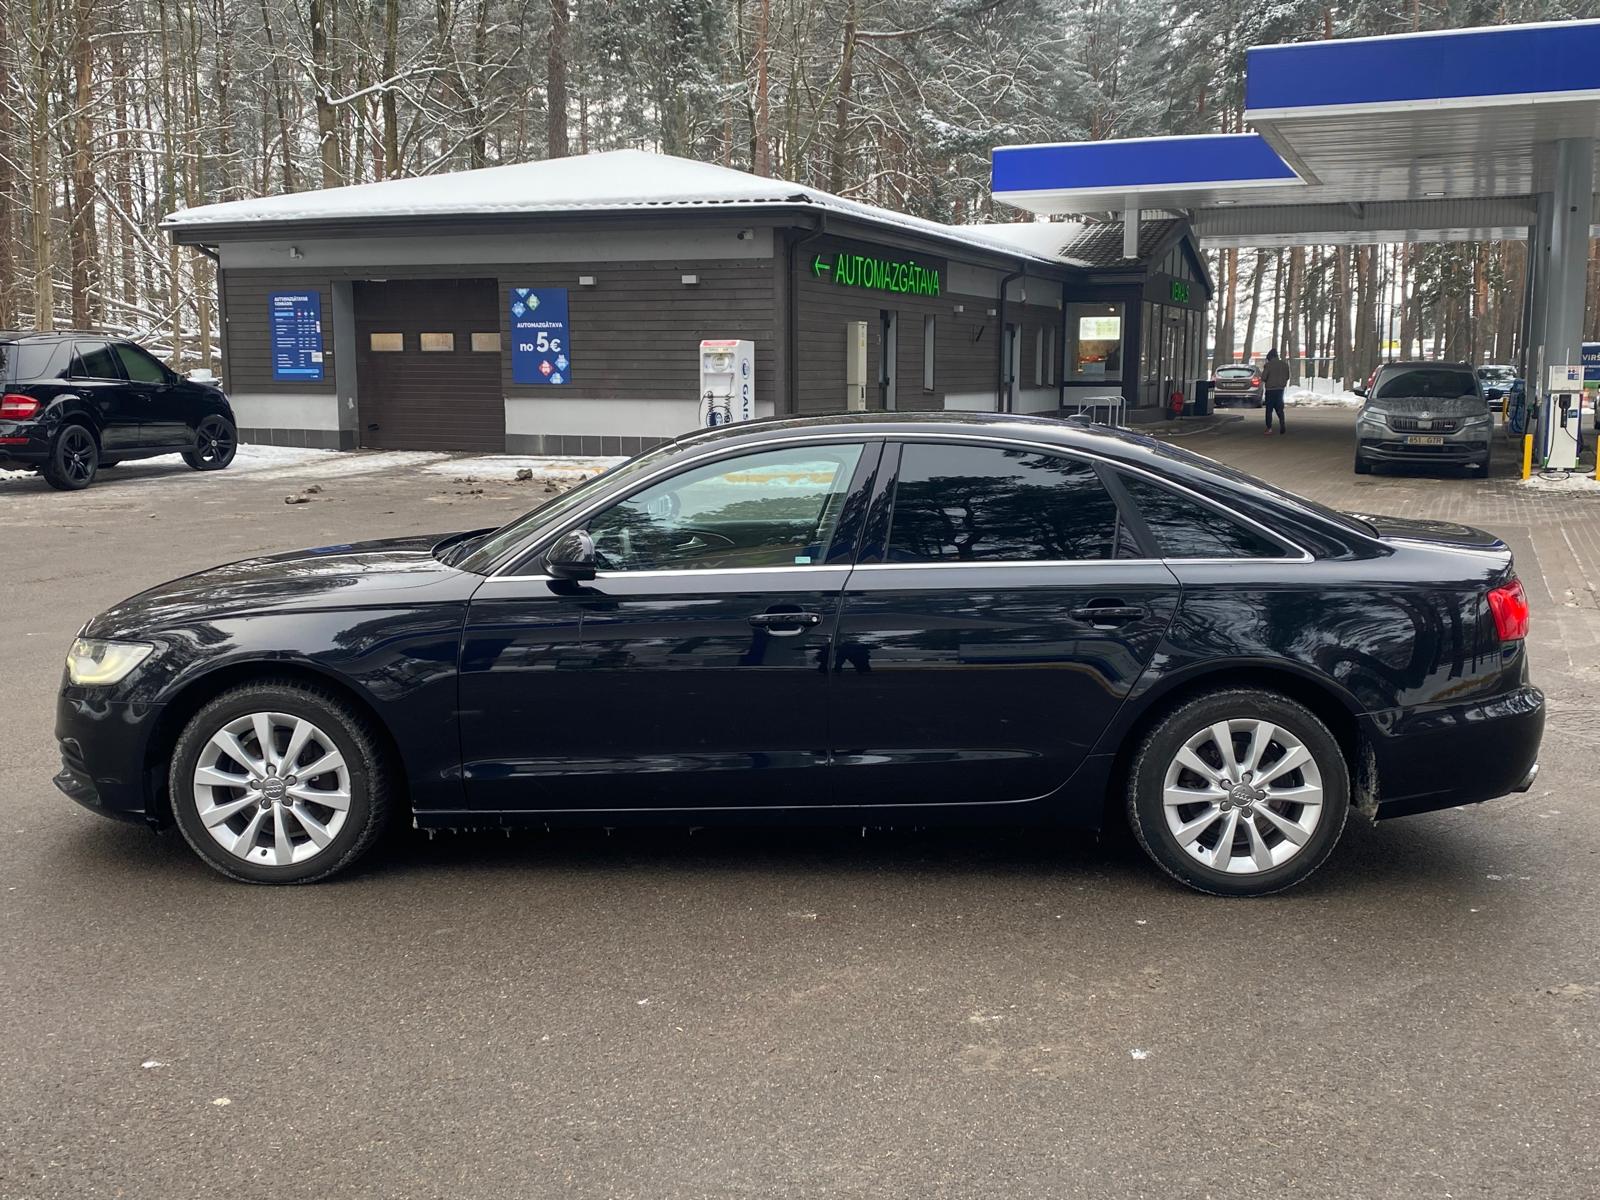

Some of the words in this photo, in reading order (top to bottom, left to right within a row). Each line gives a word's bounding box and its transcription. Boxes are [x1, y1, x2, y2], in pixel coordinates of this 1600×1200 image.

[836, 253, 940, 296] AUTOMAZGĀTAVA
[520, 343, 533, 351] no
[537, 332, 561, 352] 5€
